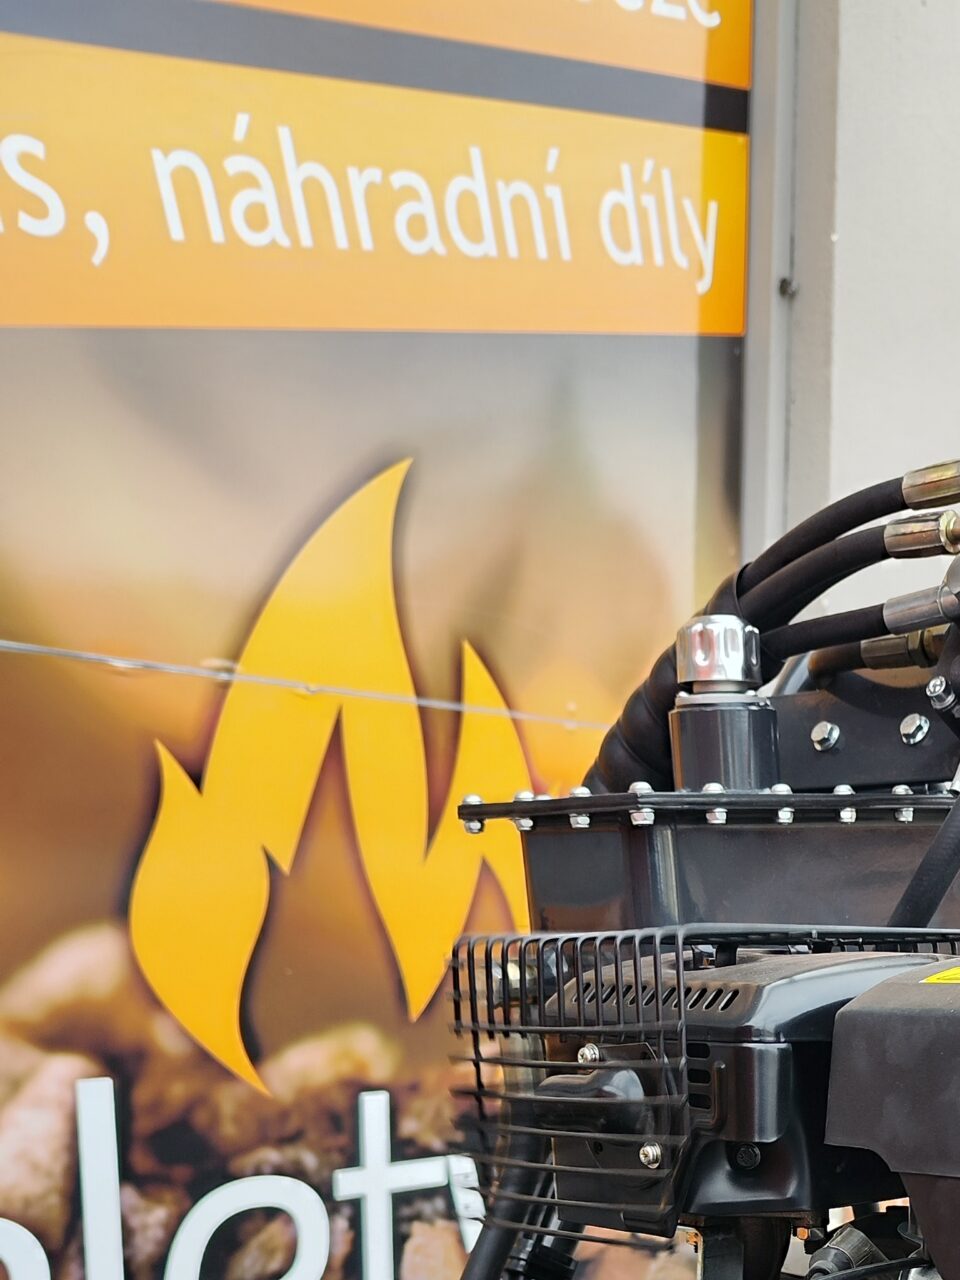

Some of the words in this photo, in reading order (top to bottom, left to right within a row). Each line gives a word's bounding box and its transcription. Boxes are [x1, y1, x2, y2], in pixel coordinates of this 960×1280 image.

[0, 132, 110, 266] s,
[150, 113, 572, 262] náhradní
[599, 159, 719, 294] díly
